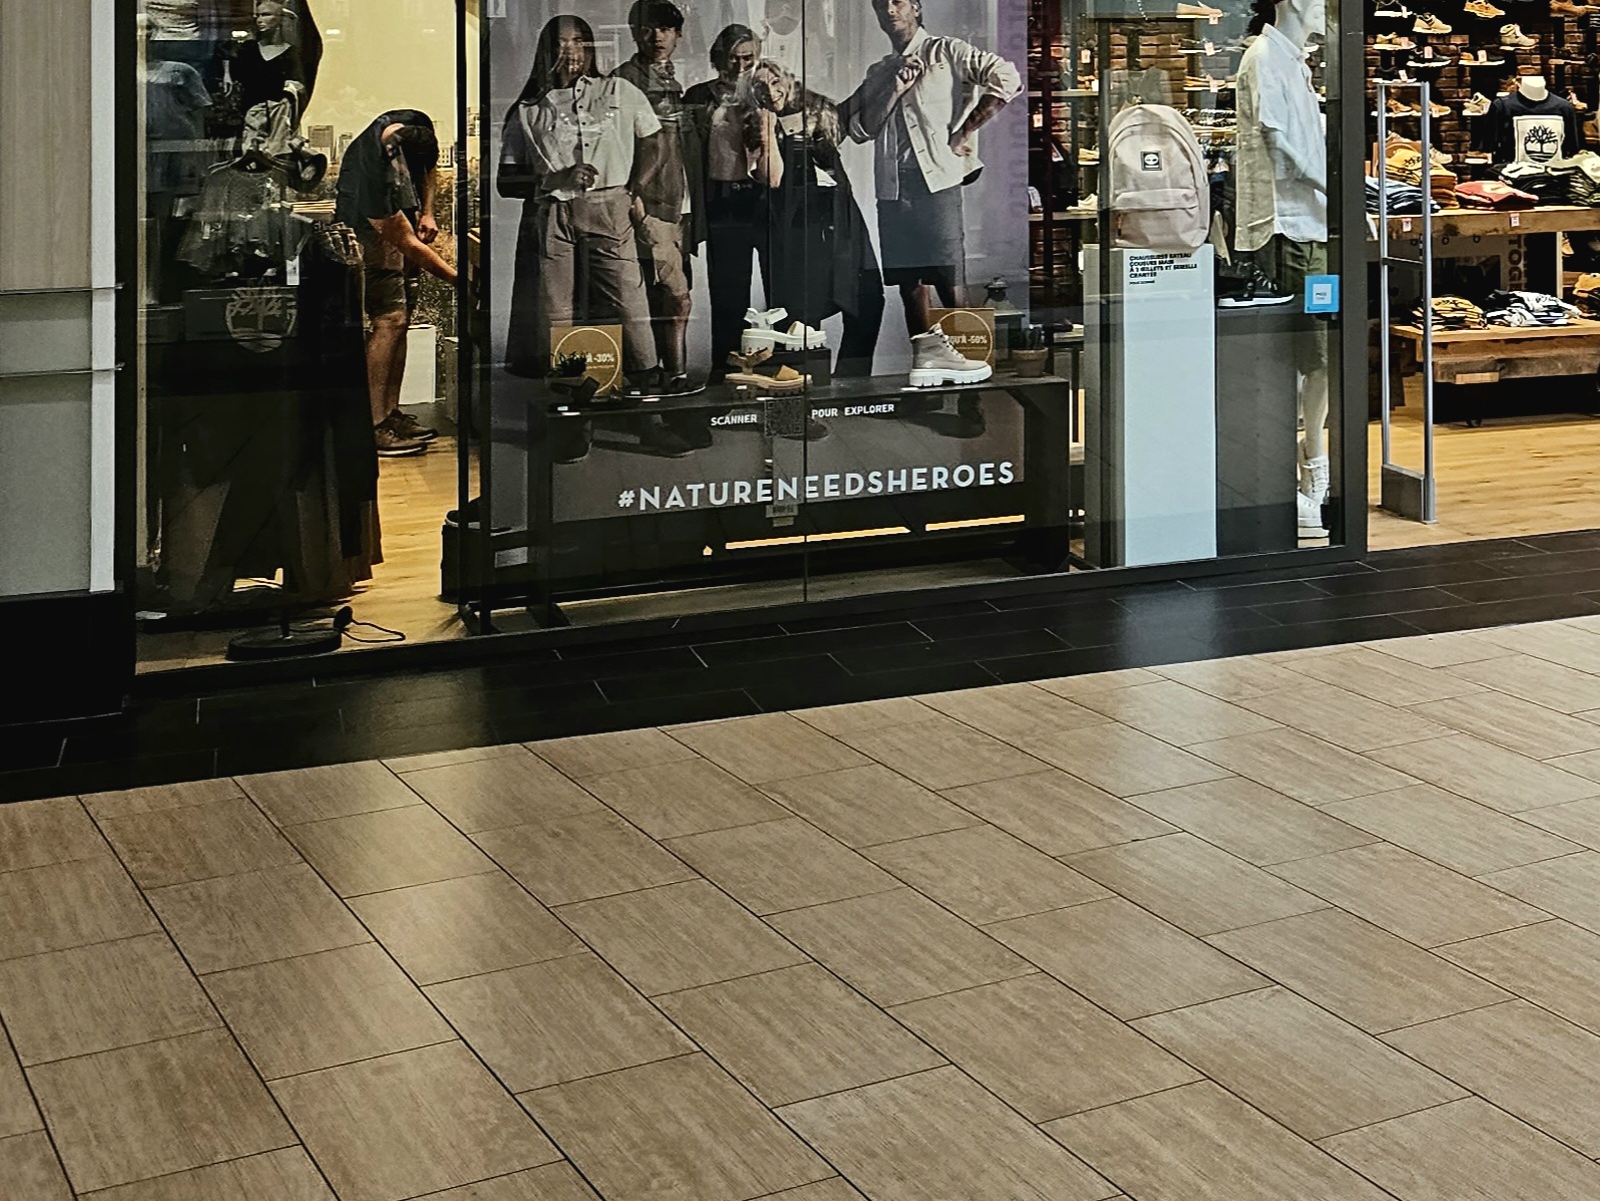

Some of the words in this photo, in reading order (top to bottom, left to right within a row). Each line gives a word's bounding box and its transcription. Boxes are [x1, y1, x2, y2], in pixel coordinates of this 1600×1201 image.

[710, 414, 758, 426] SCANNER
[811, 408, 838, 419] POUR
[844, 403, 895, 416] EXPLORER
[618, 461, 1015, 510] #NATURENEEDSHEROES
